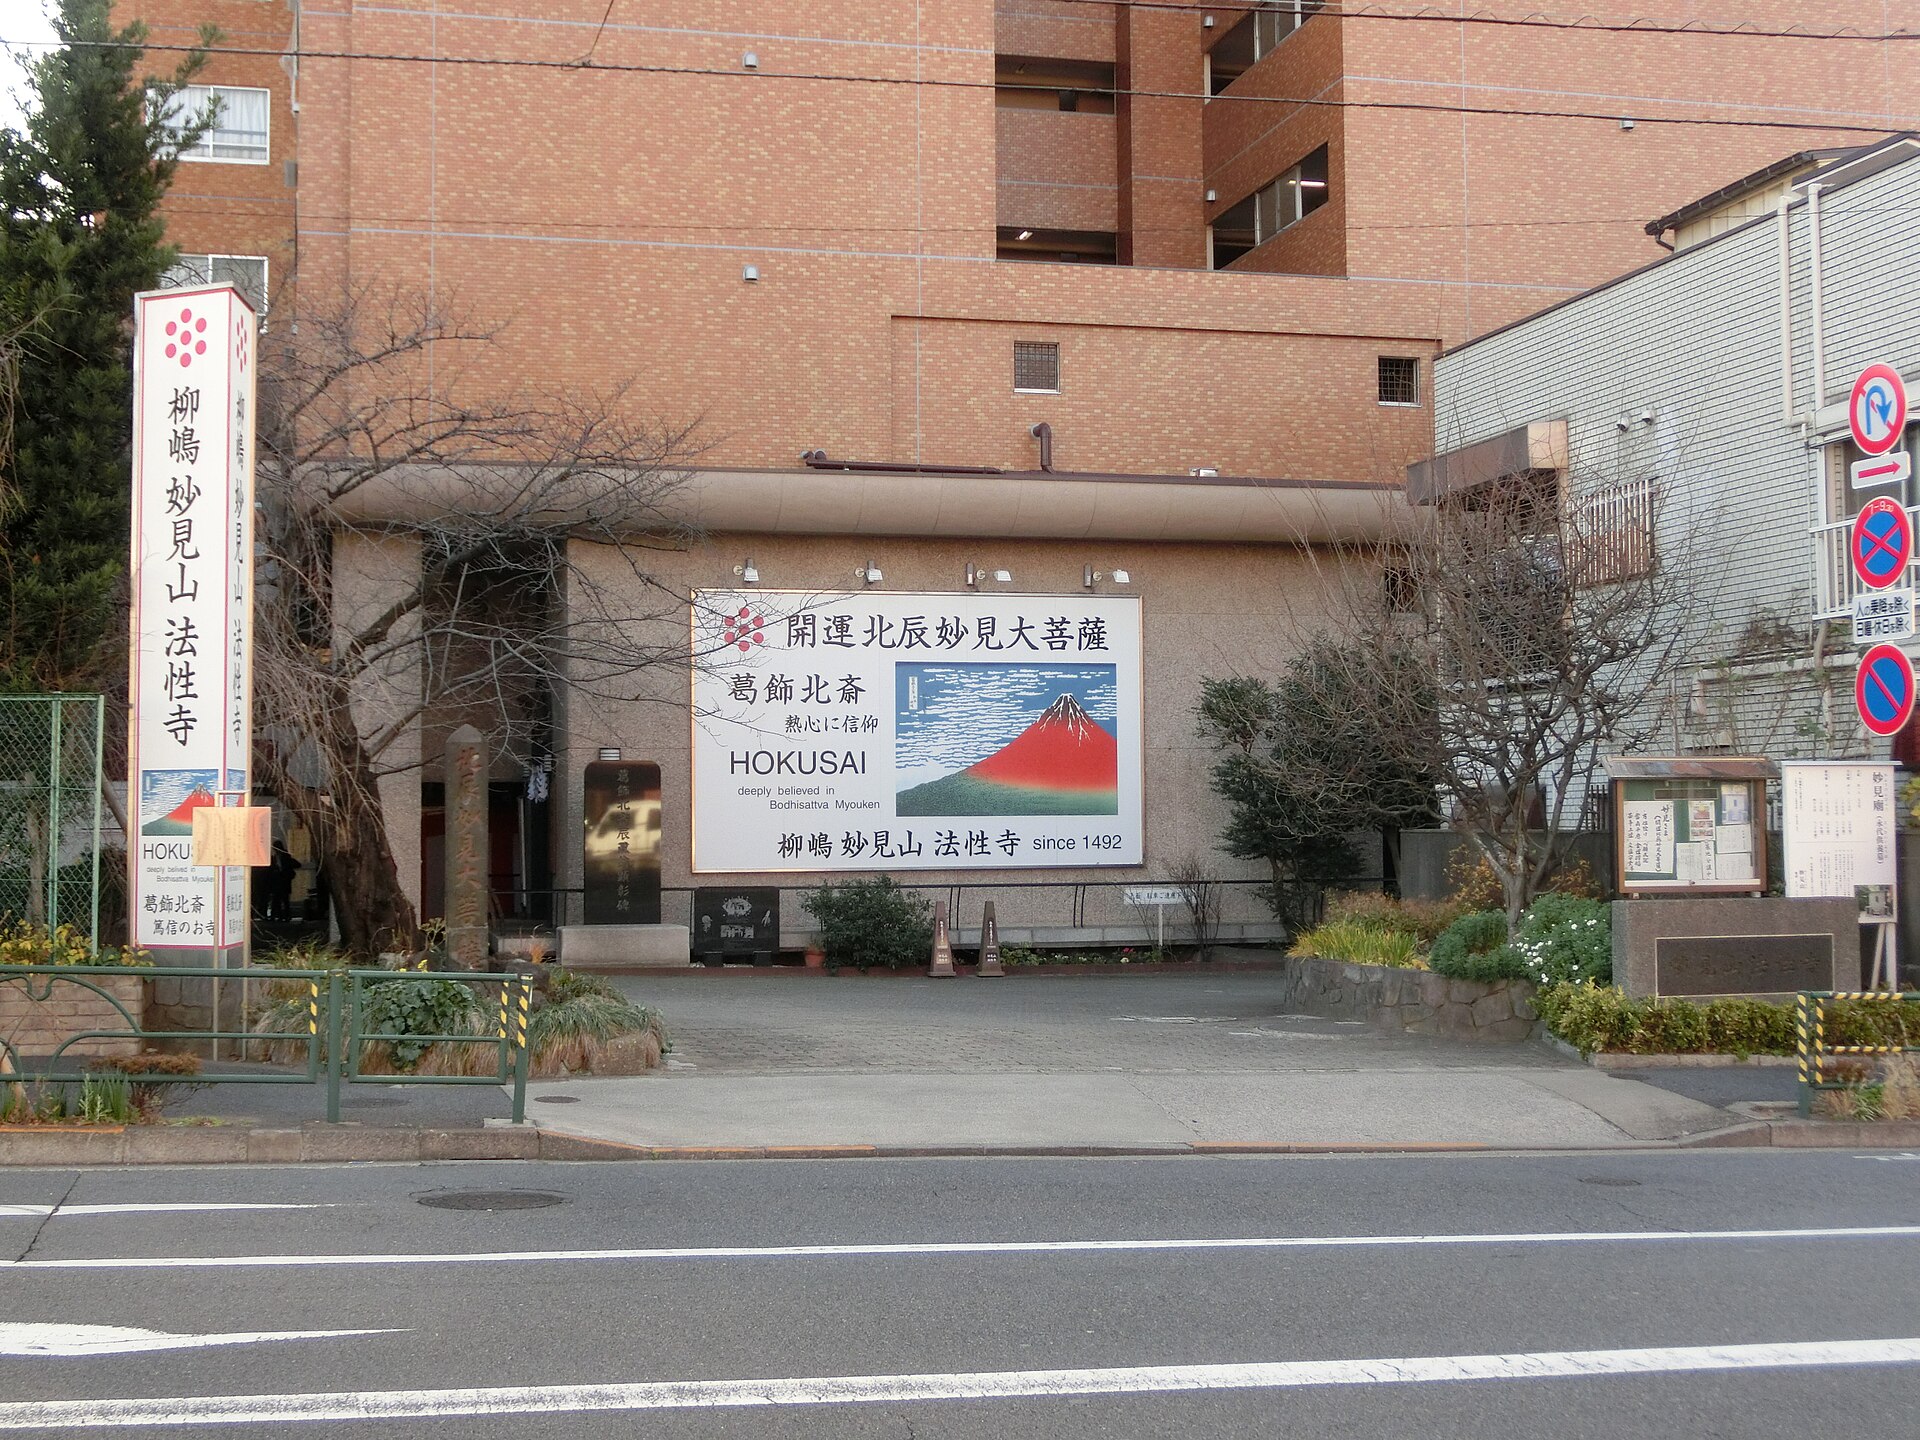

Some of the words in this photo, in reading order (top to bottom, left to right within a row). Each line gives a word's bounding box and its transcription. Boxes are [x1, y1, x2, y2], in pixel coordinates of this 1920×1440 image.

[1856, 597, 1910, 617] 人の乗降を除く
[786, 613, 1110, 652] 開運北辰妙見大菩薩
[728, 673, 867, 706] 葛飾北斎
[785, 713, 879, 735] 熱心に信仰
[729, 750, 867, 775] HOKUSAI
[737, 785, 771, 798] deeply
[777, 785, 819, 796] believed
[825, 785, 835, 796] in
[769, 799, 829, 811] Bodhisattva
[835, 799, 880, 812] Myouken
[143, 843, 193, 860] HOKU
[1033, 836, 1076, 850] since
[1082, 835, 1122, 850] 1492
[143, 894, 205, 914] 葛飾北斎
[152, 919, 215, 936] 篤信のお寺
